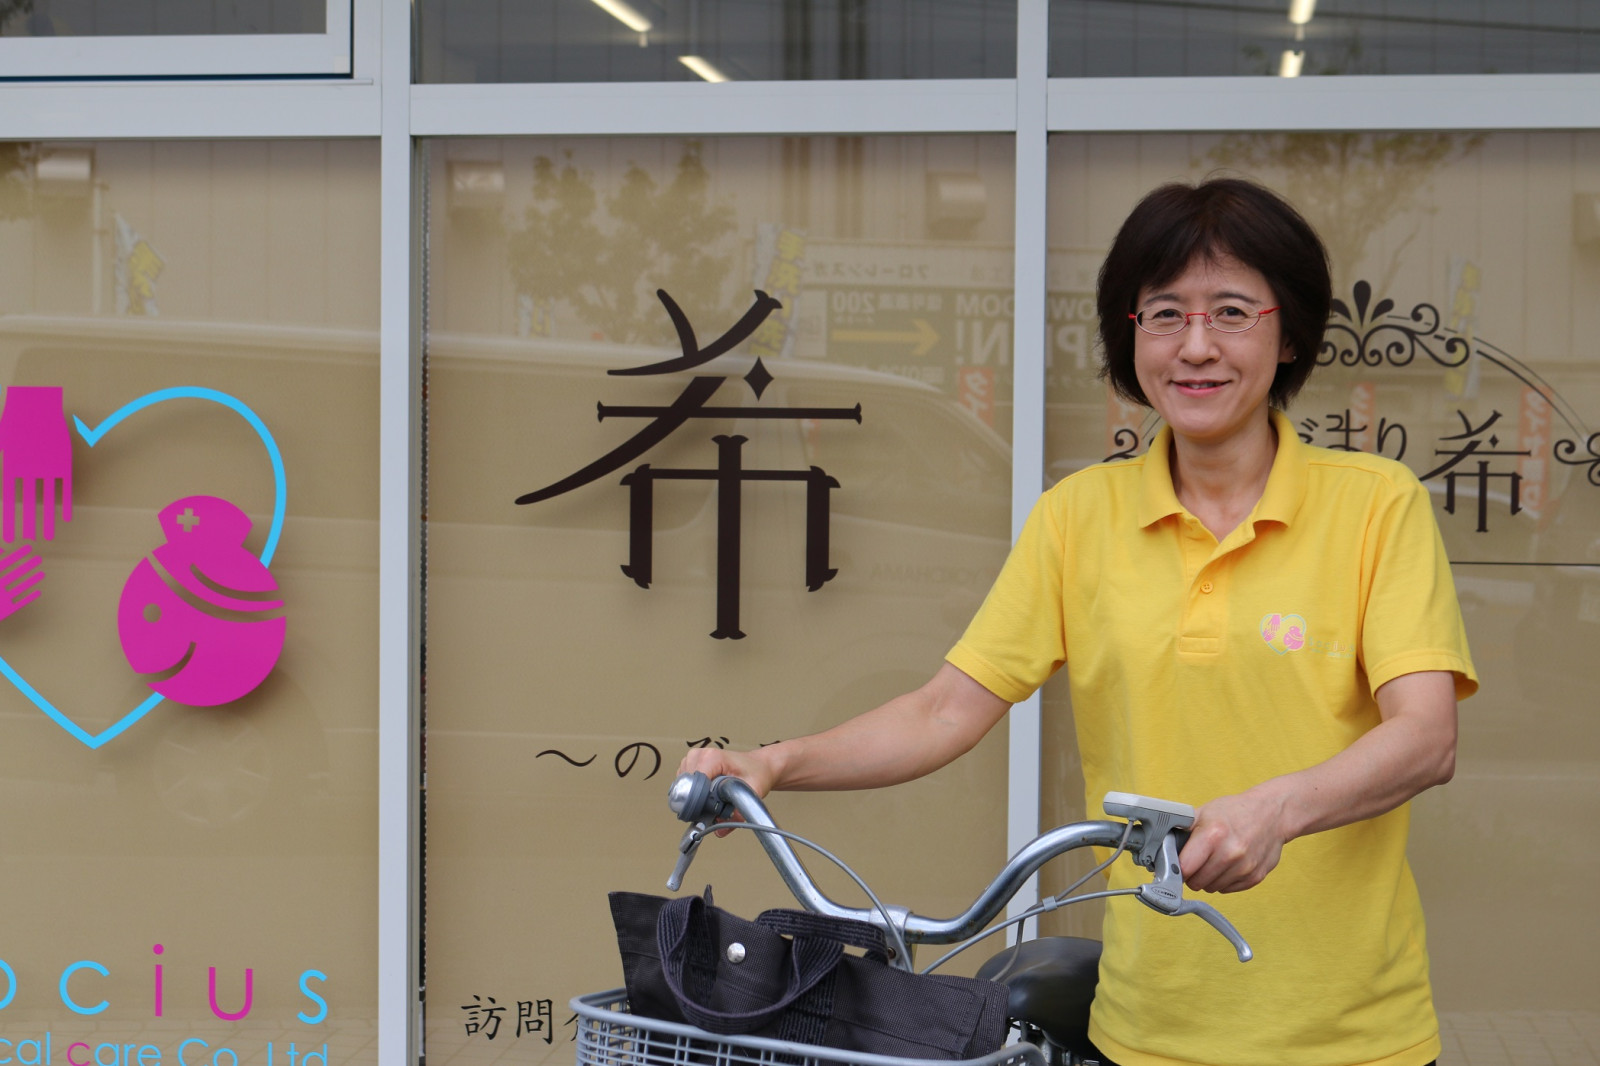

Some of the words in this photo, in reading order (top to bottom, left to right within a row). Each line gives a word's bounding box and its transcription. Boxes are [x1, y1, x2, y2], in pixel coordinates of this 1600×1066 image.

[514, 288, 863, 640] 希
[1418, 409, 1531, 532] 希
[67, 1042, 162, 1066] care
[461, 994, 579, 1045] 訪問
